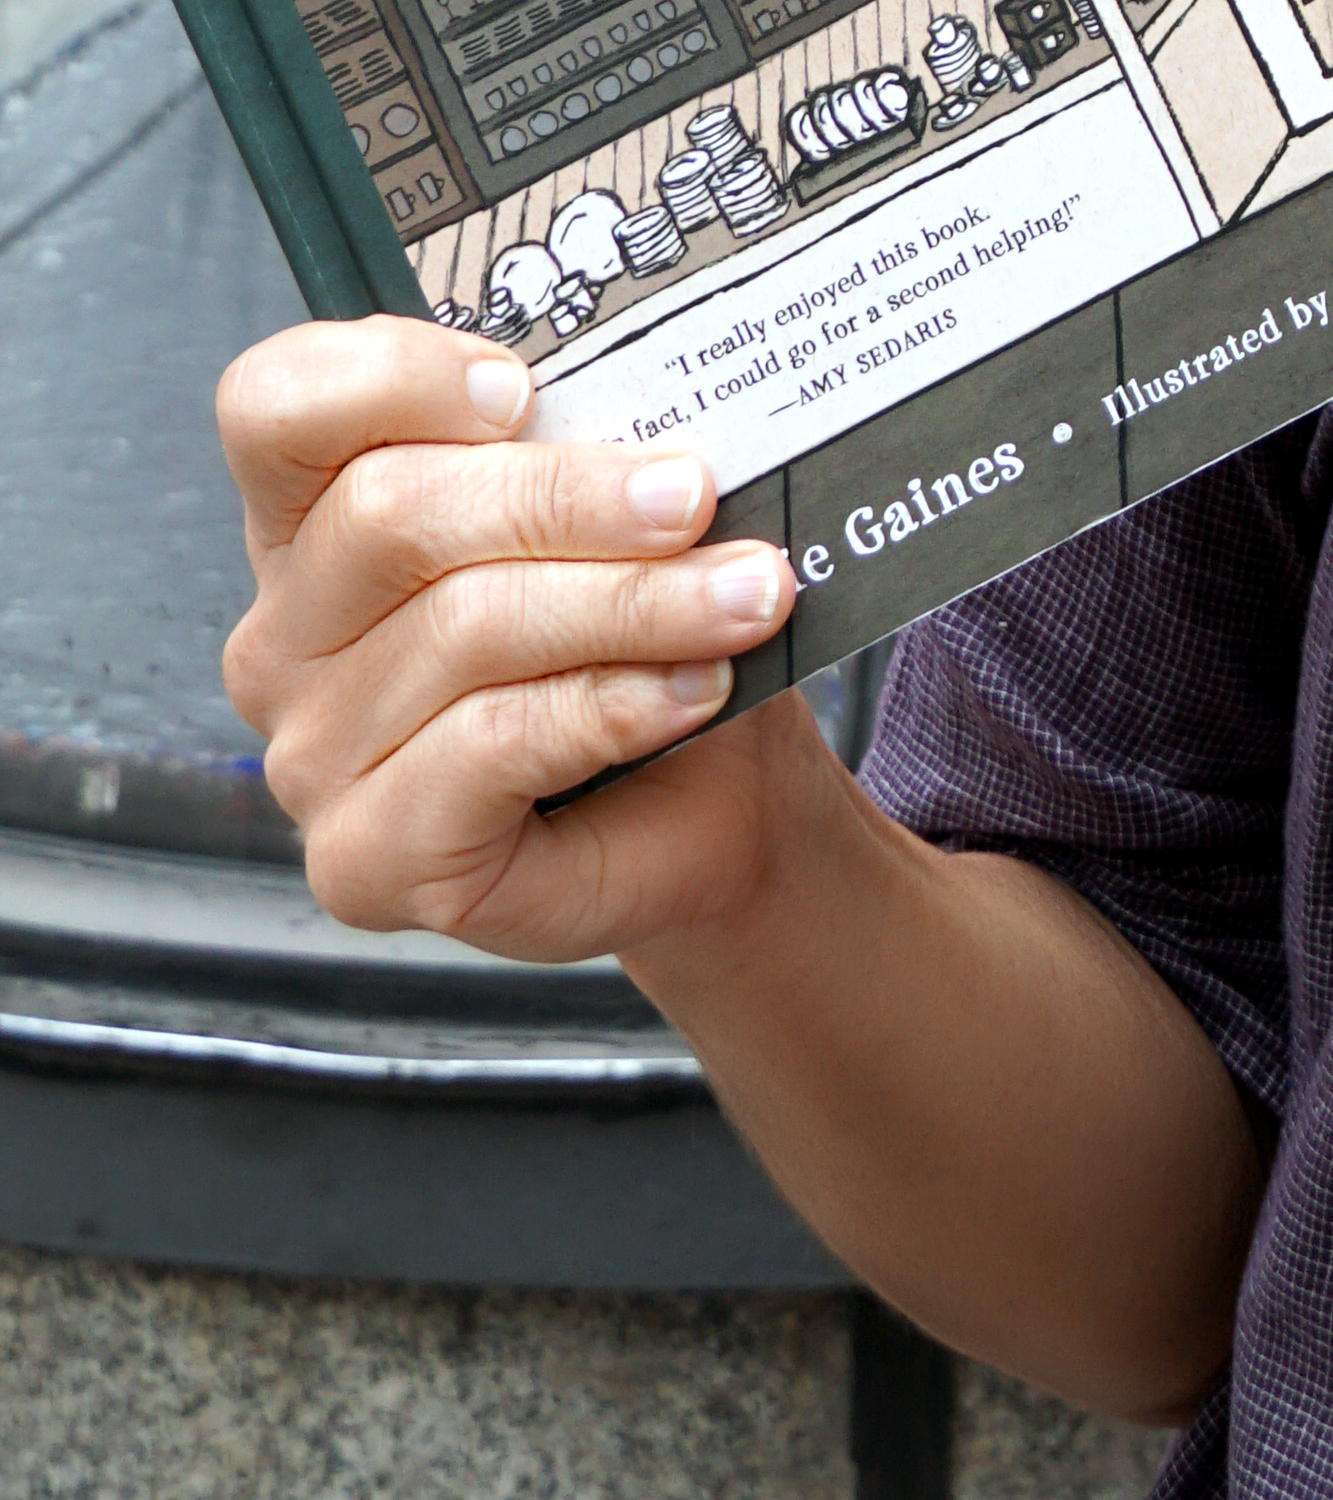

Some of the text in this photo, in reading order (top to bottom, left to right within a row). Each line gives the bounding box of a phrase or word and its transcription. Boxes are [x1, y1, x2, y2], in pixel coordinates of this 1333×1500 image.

[633, 406, 691, 442] fact,
[693, 391, 709, 412] I
[714, 351, 783, 401] could
[788, 340, 817, 371] go
[821, 314, 860, 355] for
[867, 304, 883, 323] a
[887, 253, 971, 313] second
[697, 317, 767, 368] really
[774, 263, 868, 328] enjoyed
[870, 237, 919, 276] this
[922, 203, 991, 250] book.
[856, 308, 959, 375] SEDARIS
[845, 438, 1026, 555] Gaines
[1100, 317, 1283, 427] Illustrated
[1284, 290, 1331, 334] by
